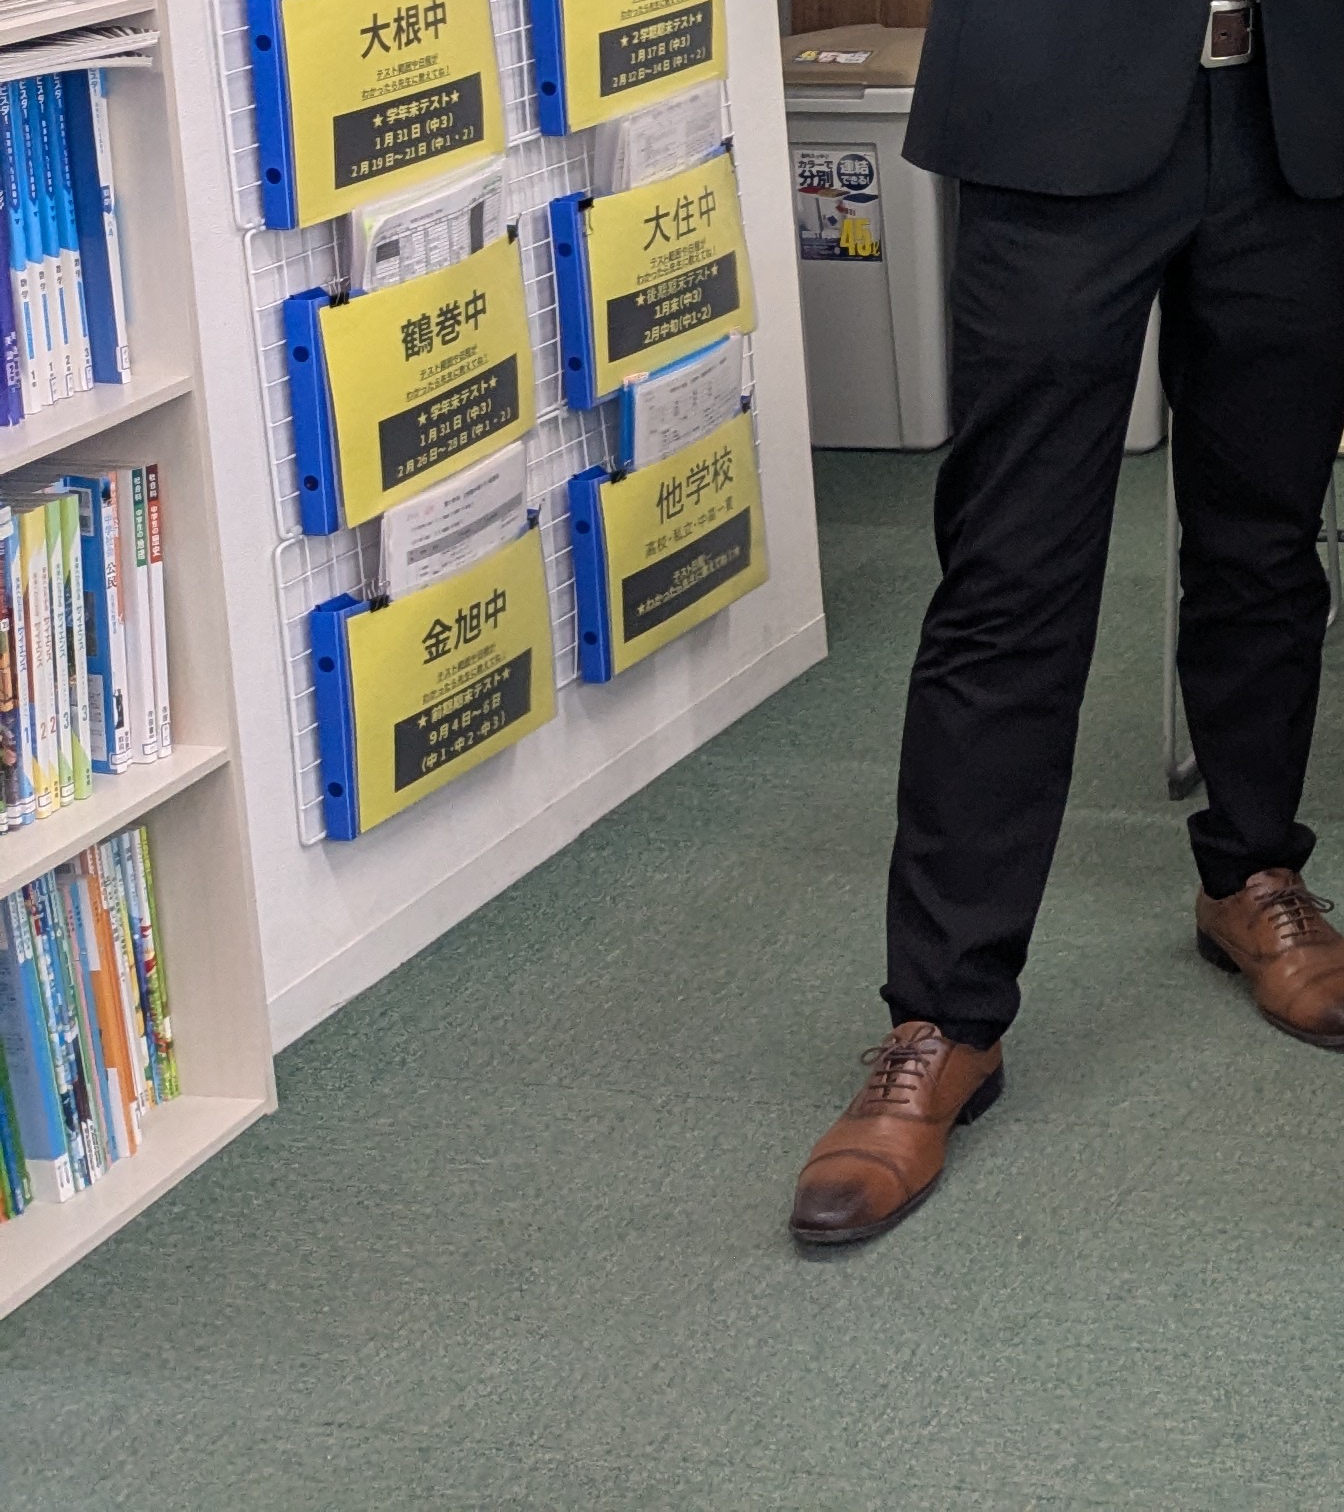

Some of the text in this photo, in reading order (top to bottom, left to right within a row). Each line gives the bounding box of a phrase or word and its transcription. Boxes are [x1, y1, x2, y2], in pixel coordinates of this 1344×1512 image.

[386, 92, 450, 125] 学年末テスト
[797, 168, 835, 188] 分別
[839, 159, 870, 175] 連結
[643, 185, 716, 252] 大住中
[400, 289, 487, 363] 鶴巻中
[656, 445, 734, 525] 他学校
[105, 562, 118, 590] 公民
[421, 587, 507, 666] 金旭中
